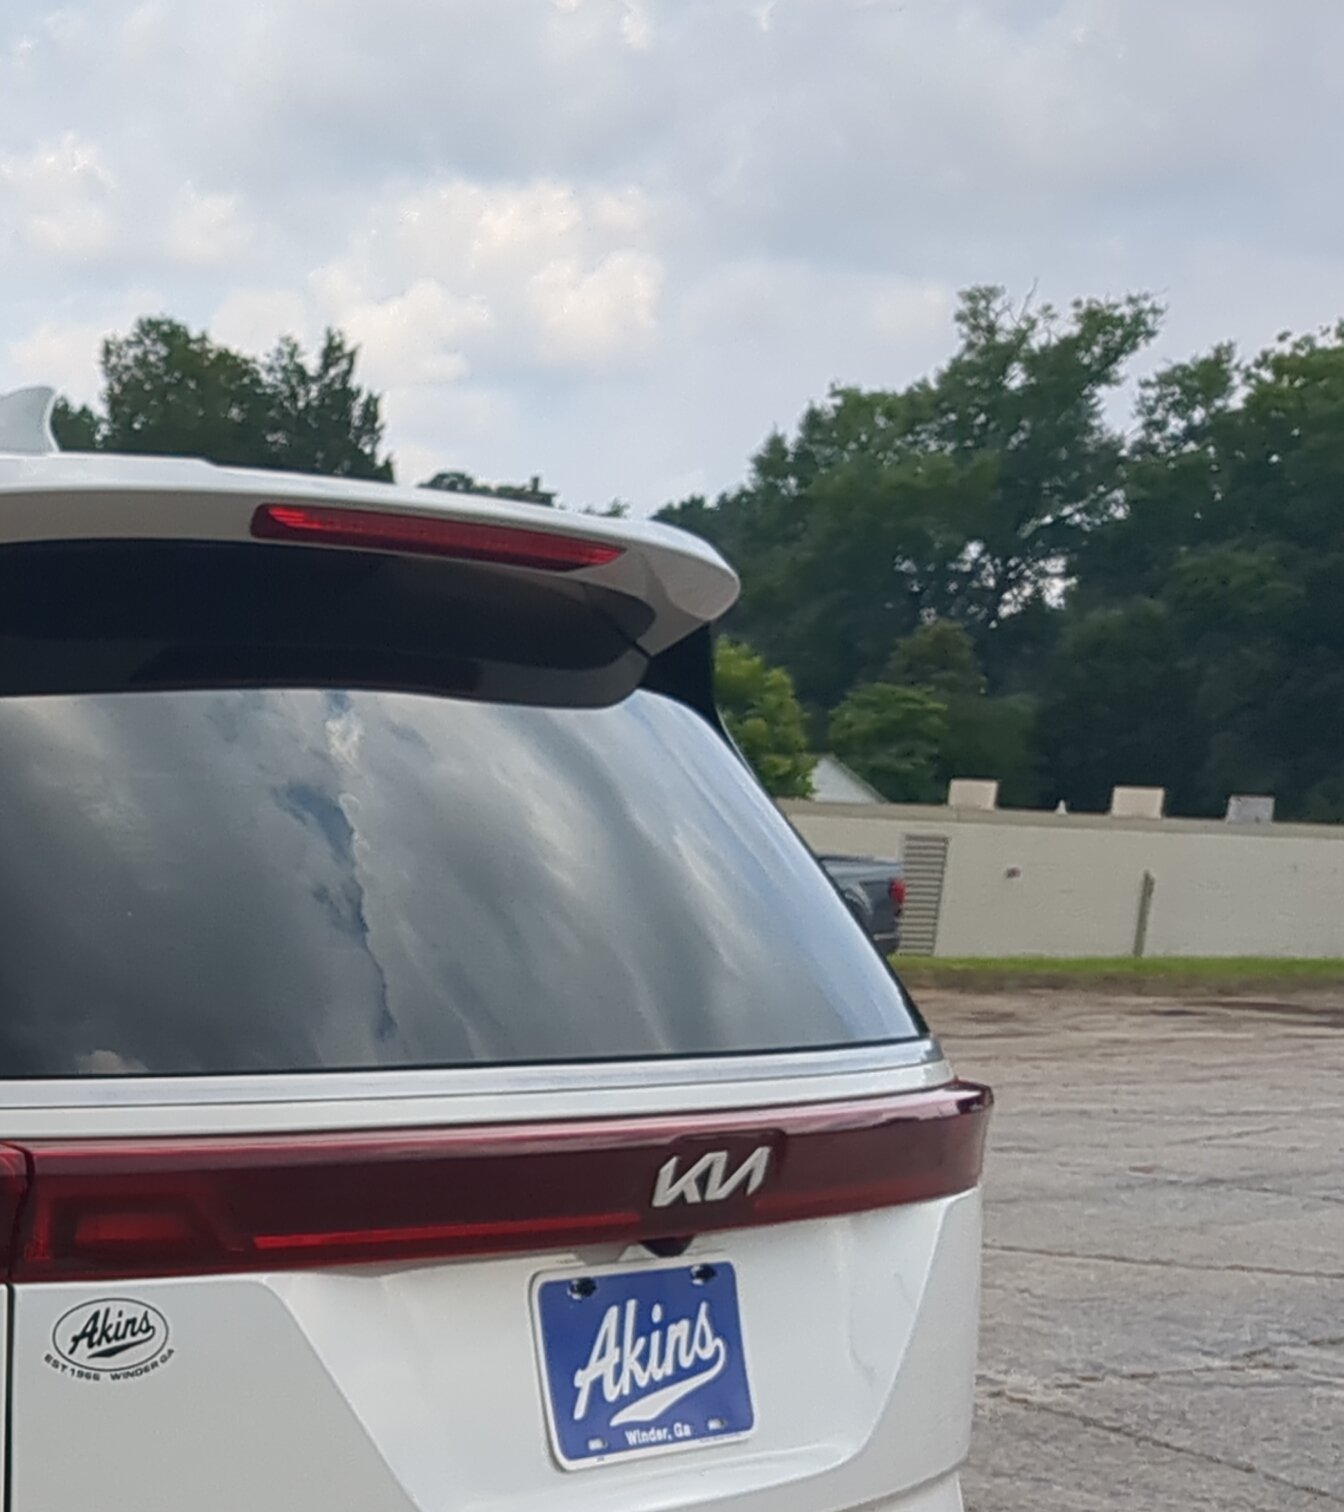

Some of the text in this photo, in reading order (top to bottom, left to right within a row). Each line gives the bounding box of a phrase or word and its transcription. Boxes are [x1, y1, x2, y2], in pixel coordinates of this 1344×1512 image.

[68, 1307, 156, 1358] Akins
[110, 1360, 160, 1381] WINDER
[573, 1299, 726, 1422] Akins
[625, 1421, 692, 1446] Winder, Ga
